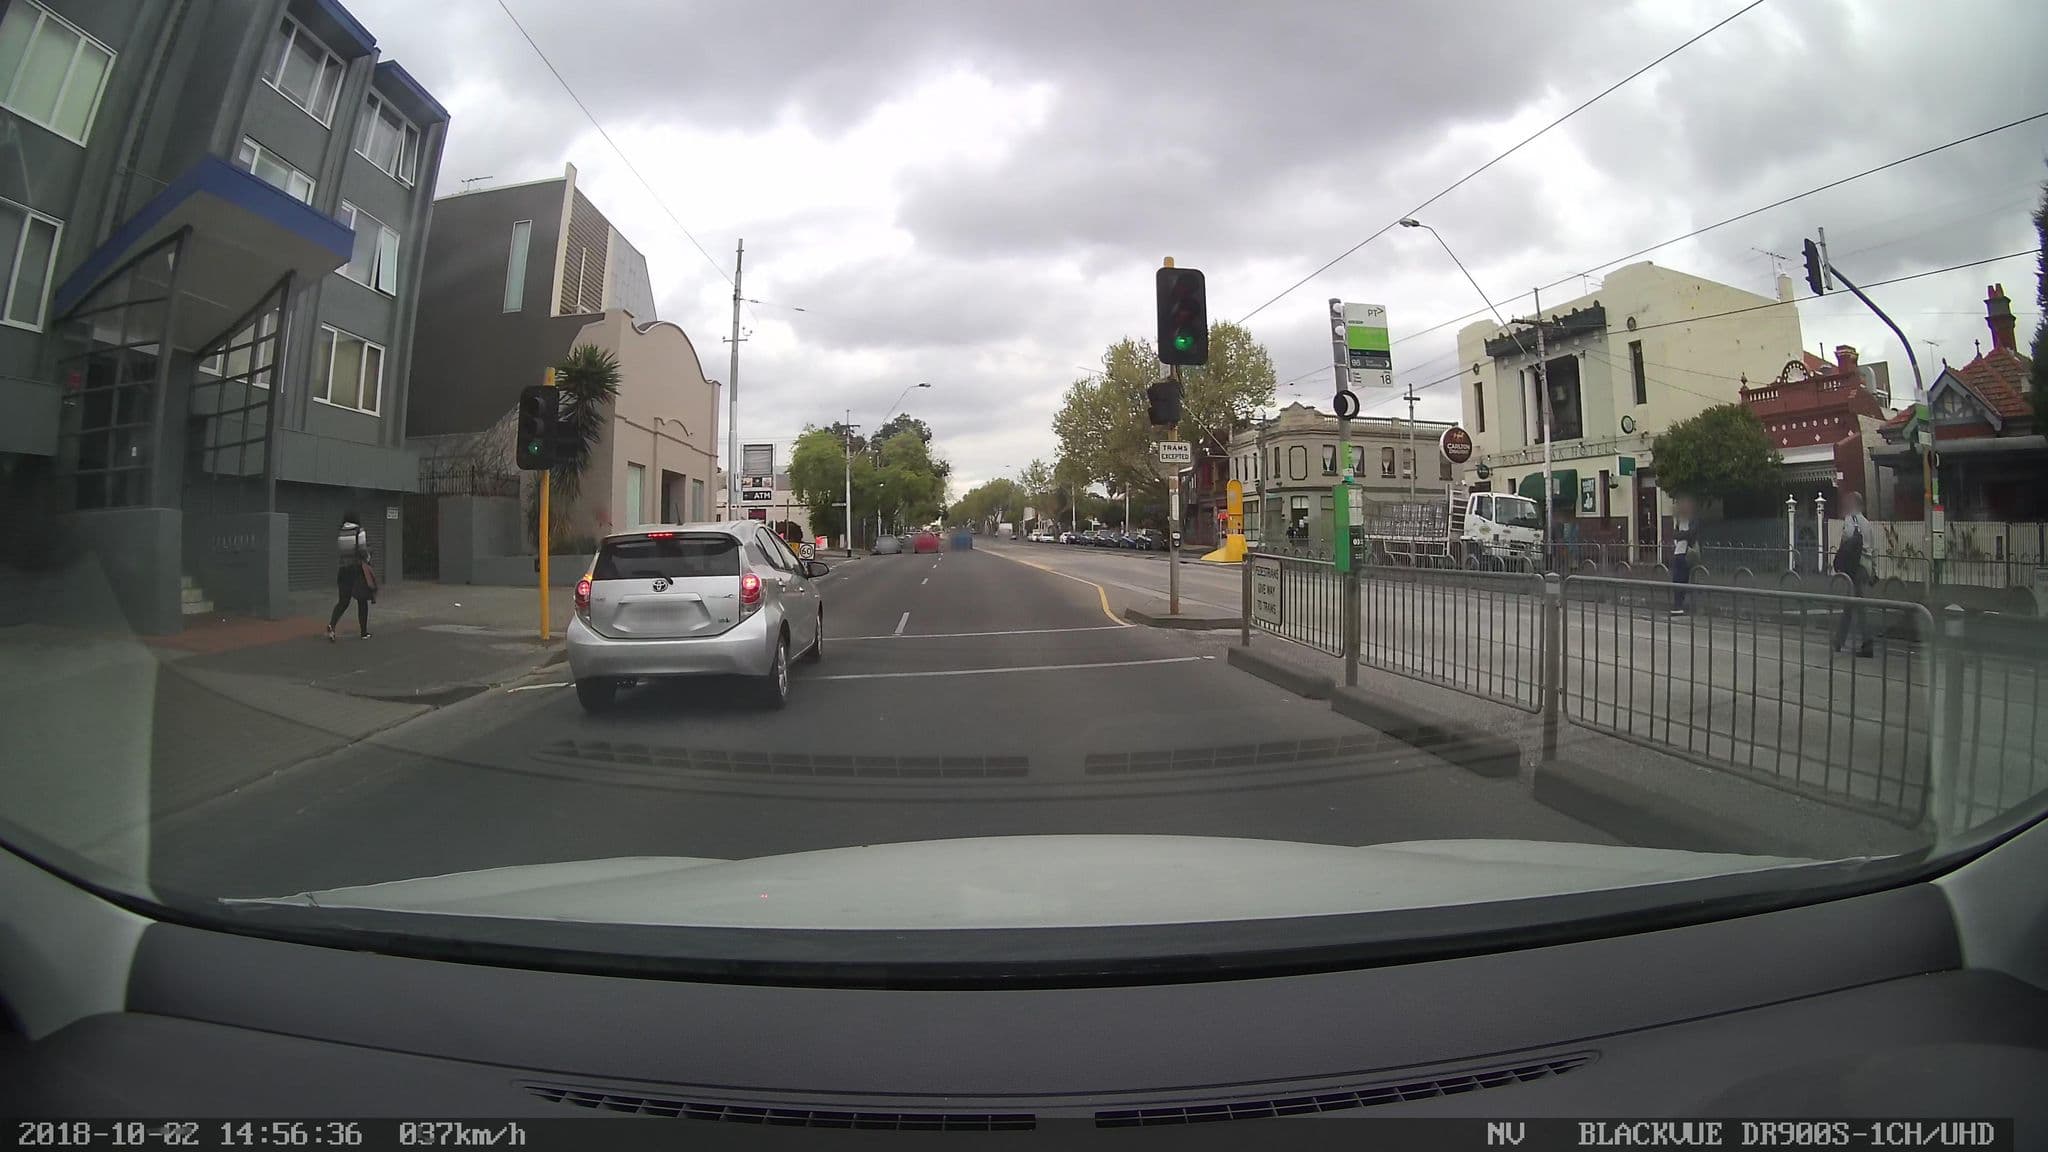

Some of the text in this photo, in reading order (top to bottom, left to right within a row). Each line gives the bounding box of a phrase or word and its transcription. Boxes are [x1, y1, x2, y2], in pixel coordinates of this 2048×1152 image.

[1380, 374, 1392, 385] 18
[1572, 443, 1612, 457] HOTEL
[802, 547, 811, 556] 60
